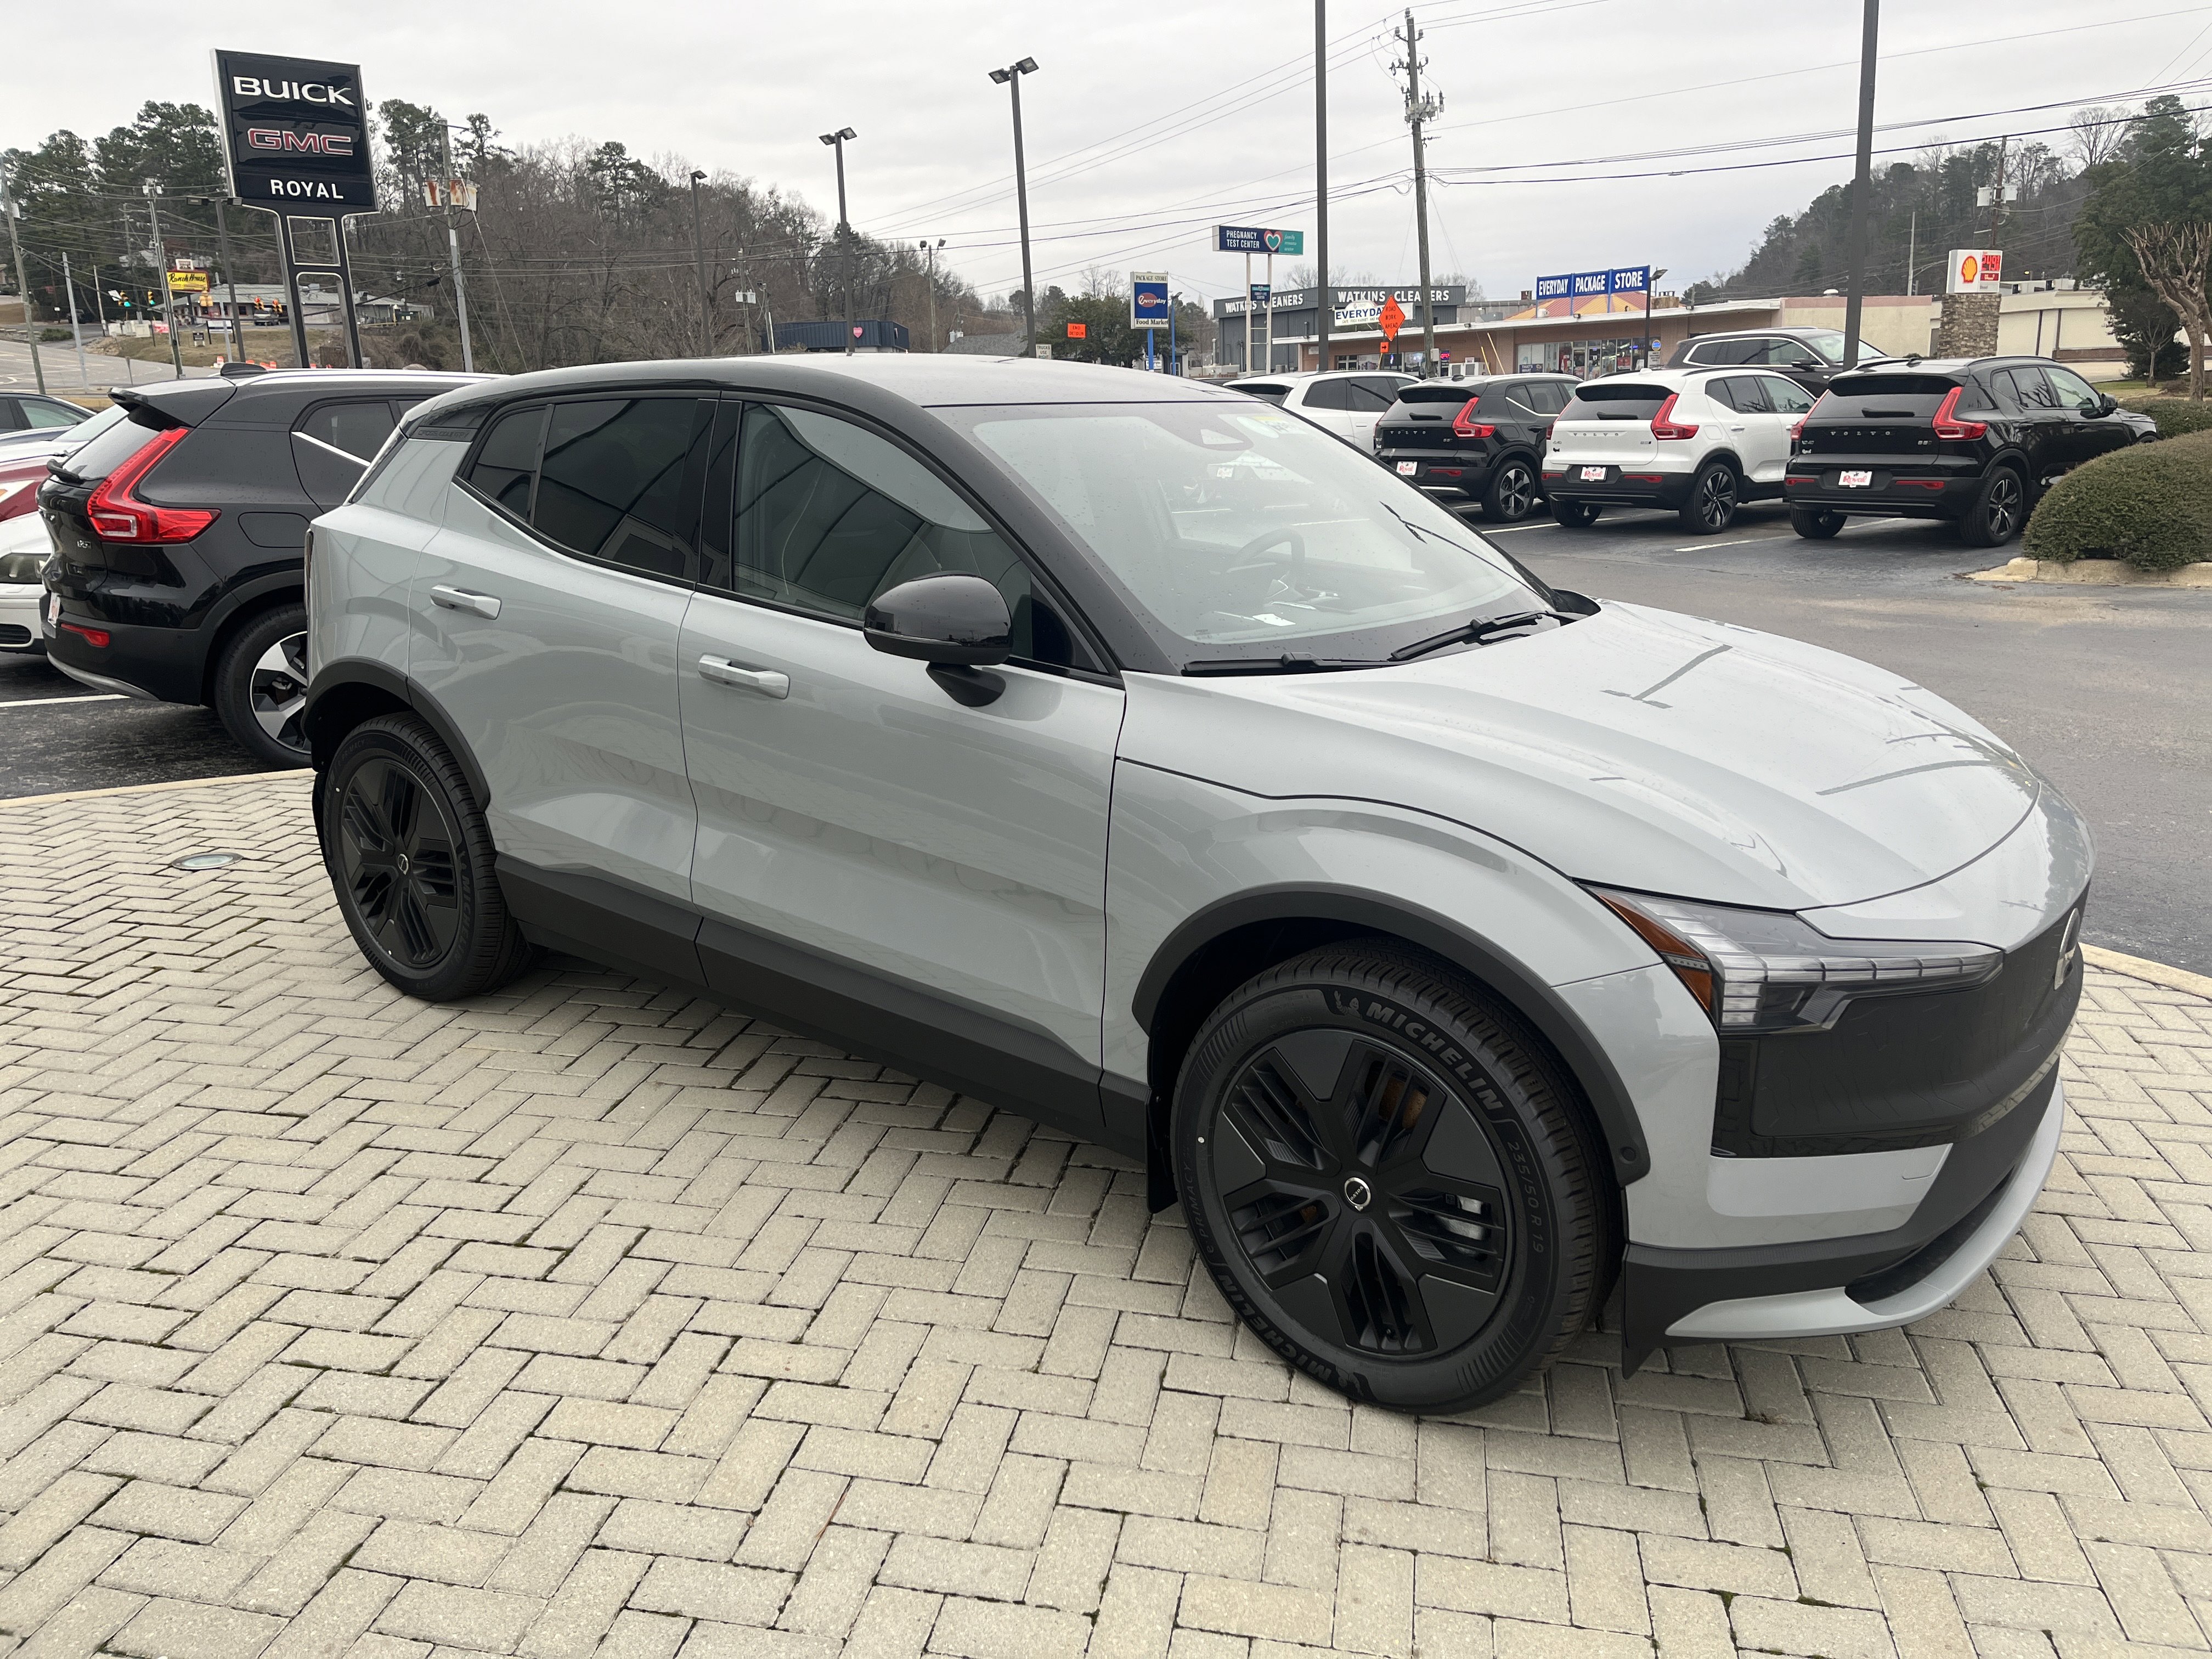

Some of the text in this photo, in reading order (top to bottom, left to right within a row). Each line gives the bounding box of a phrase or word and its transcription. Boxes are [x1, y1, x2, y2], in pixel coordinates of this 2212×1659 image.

[233, 76, 355, 105] BUICK
[247, 128, 353, 156] GMC
[270, 179, 344, 199] ROYAL
[1226, 230, 1257, 239] PREGNANCY
[1227, 239, 1260, 249] TEST CENTER
[169, 273, 206, 283] Ranch House
[1538, 270, 1643, 296] EVERYDAY PACKAGE STORE
[1138, 295, 1166, 305] everyday
[1338, 290, 1449, 302] WATKINS CLEAERS
[1336, 307, 1384, 320] EVERYDA
[1584, 470, 1603, 479] Royal
[1843, 475, 1867, 485] Royal
[1365, 1002, 1504, 1110] MICHELIN
[1507, 1141, 1540, 1208] 235/50
[1532, 1233, 1544, 1254] 19
[1218, 1274, 1332, 1381] MICHELIN
